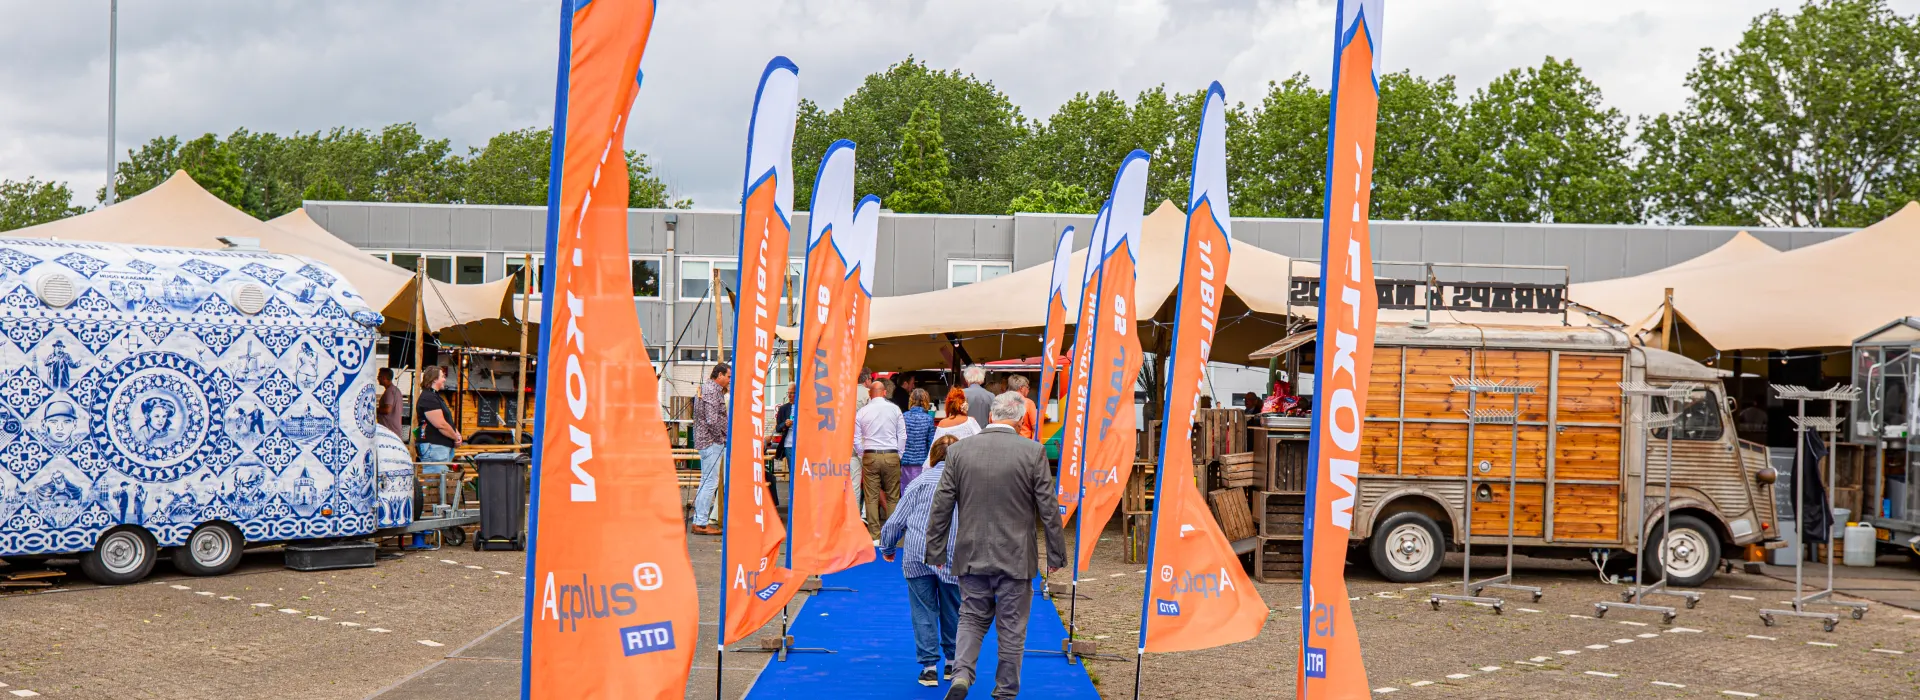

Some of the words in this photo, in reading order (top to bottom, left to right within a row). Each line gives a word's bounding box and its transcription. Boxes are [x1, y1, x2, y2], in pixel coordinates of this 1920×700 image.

[817, 284, 831, 325] 85
[814, 335, 836, 432] JAAR
[801, 457, 851, 481] Applus
[541, 571, 638, 633] Applus
[758, 583, 780, 600] RTD
[626, 627, 669, 650] RTD
